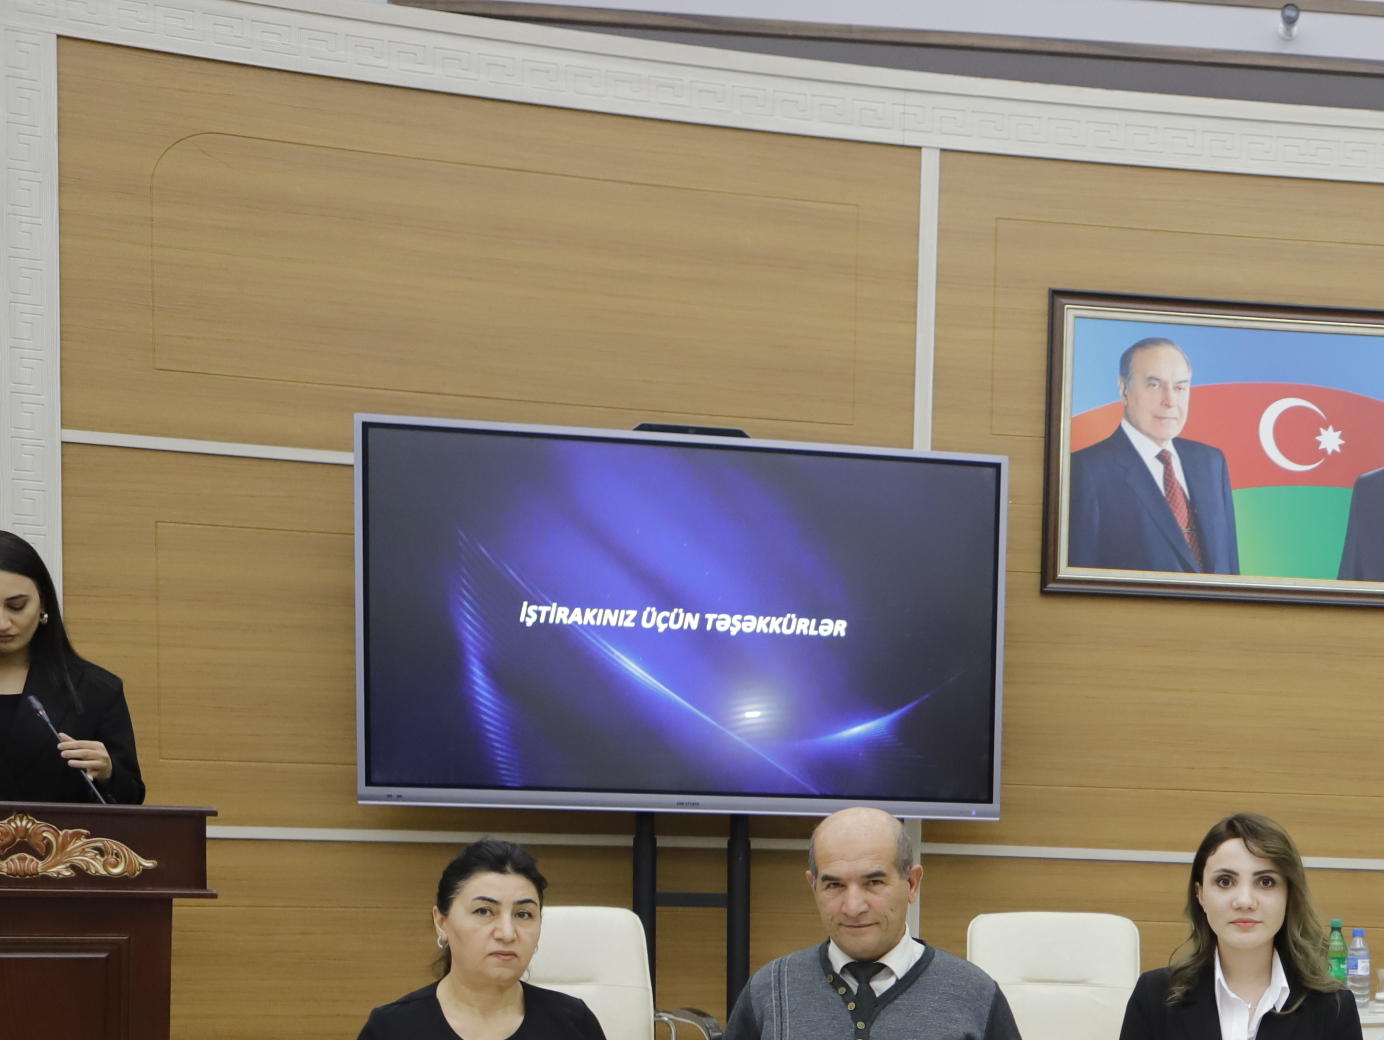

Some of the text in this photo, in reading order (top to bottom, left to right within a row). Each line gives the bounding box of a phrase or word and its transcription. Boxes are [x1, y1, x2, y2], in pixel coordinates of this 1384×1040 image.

[519, 601, 847, 636] İŞTİRAKINIZ ÜÇÜN TƏŞƏKKÜRLƏR
